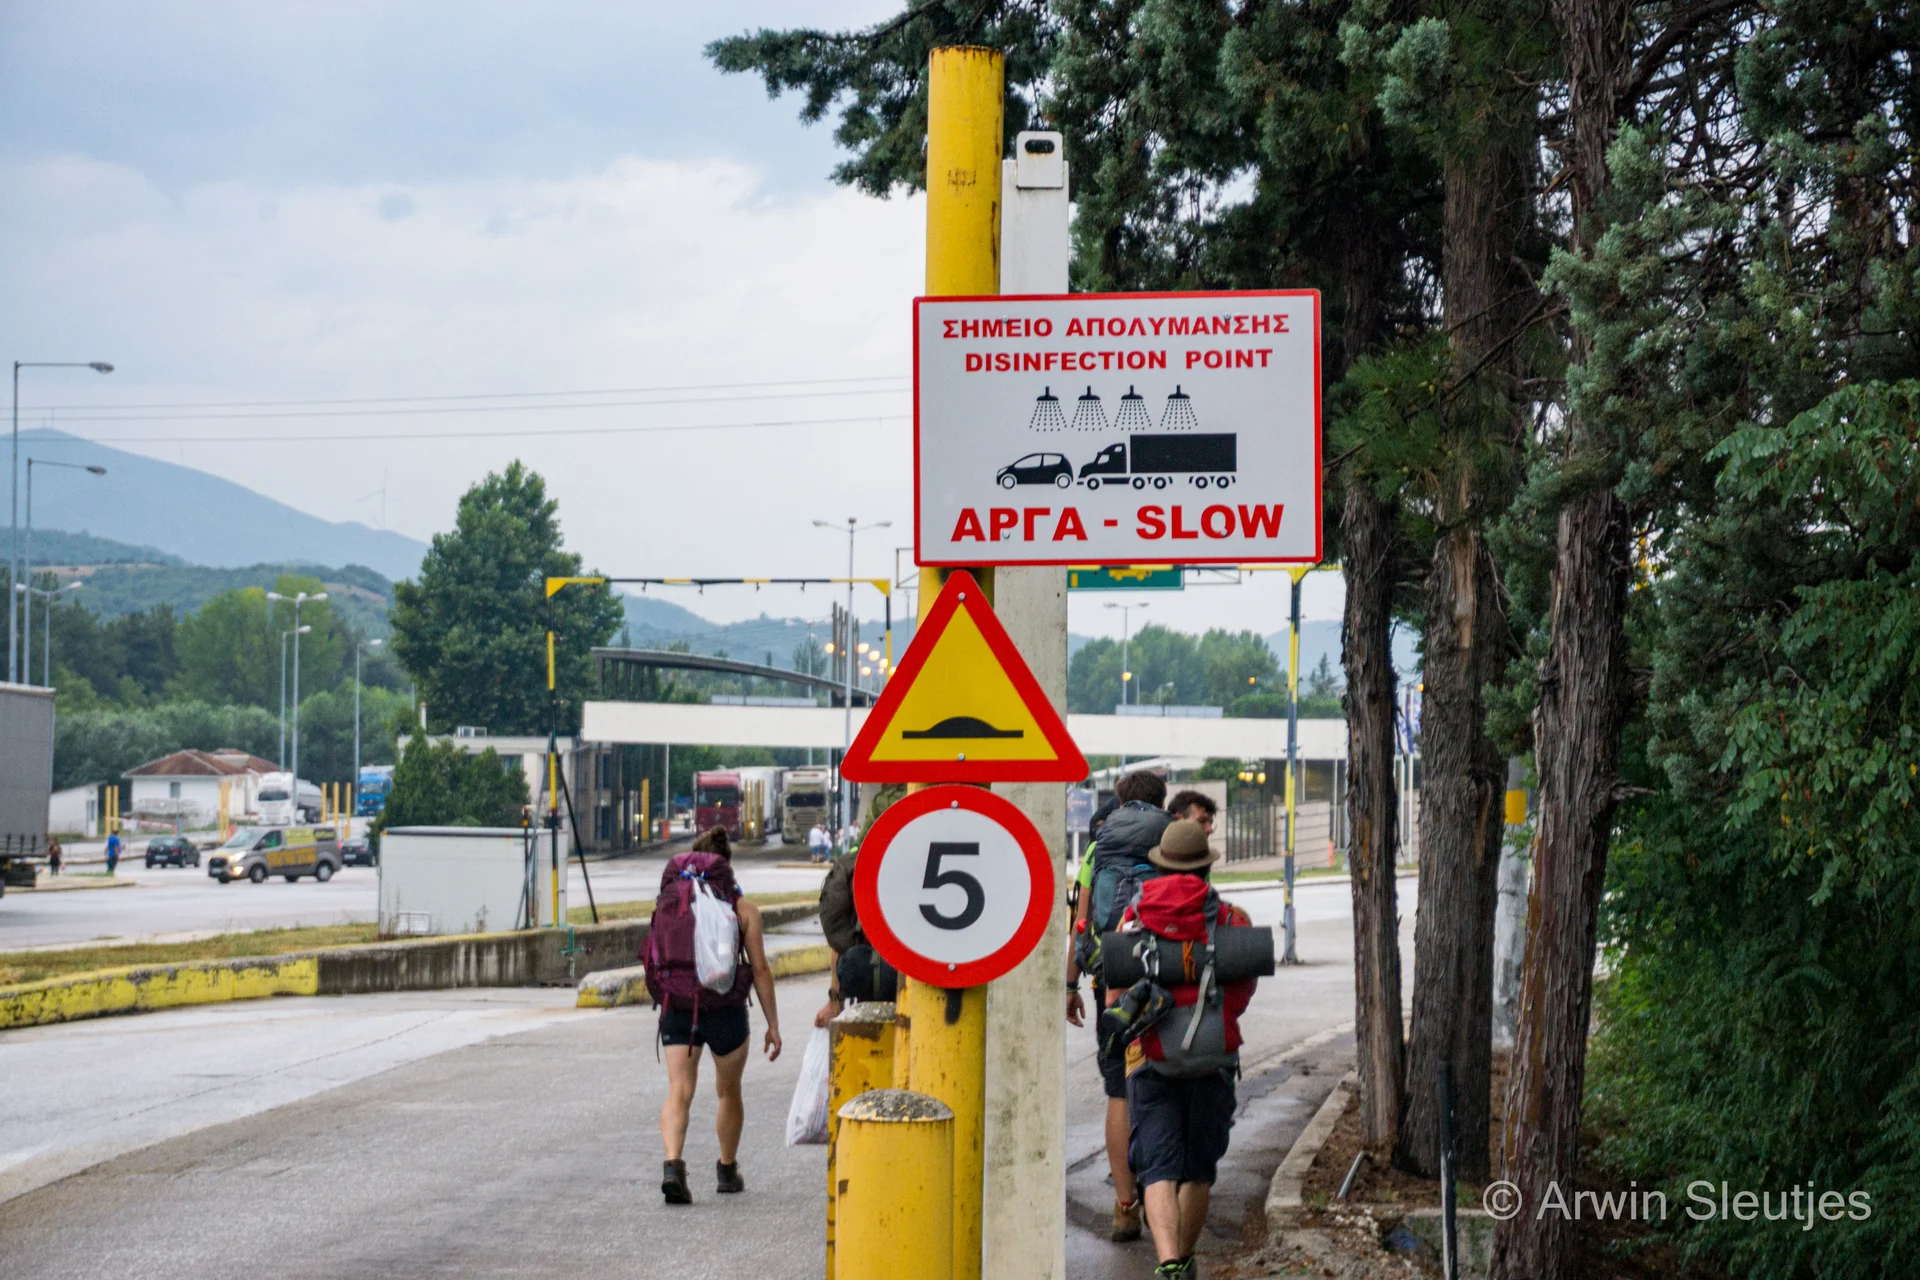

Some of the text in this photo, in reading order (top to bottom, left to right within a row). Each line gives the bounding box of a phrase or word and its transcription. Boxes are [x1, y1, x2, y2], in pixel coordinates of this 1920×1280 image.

[943, 314, 1290, 339] ΣΗΜΕΙΟ ΑΠΟΛΥΜΑΝΣΗΣ
[965, 348, 1273, 372] DISINFECTION POINT
[951, 507, 1088, 542] ΑΡΓΑ
[1136, 503, 1285, 541] SLOW
[919, 842, 985, 931] 5
